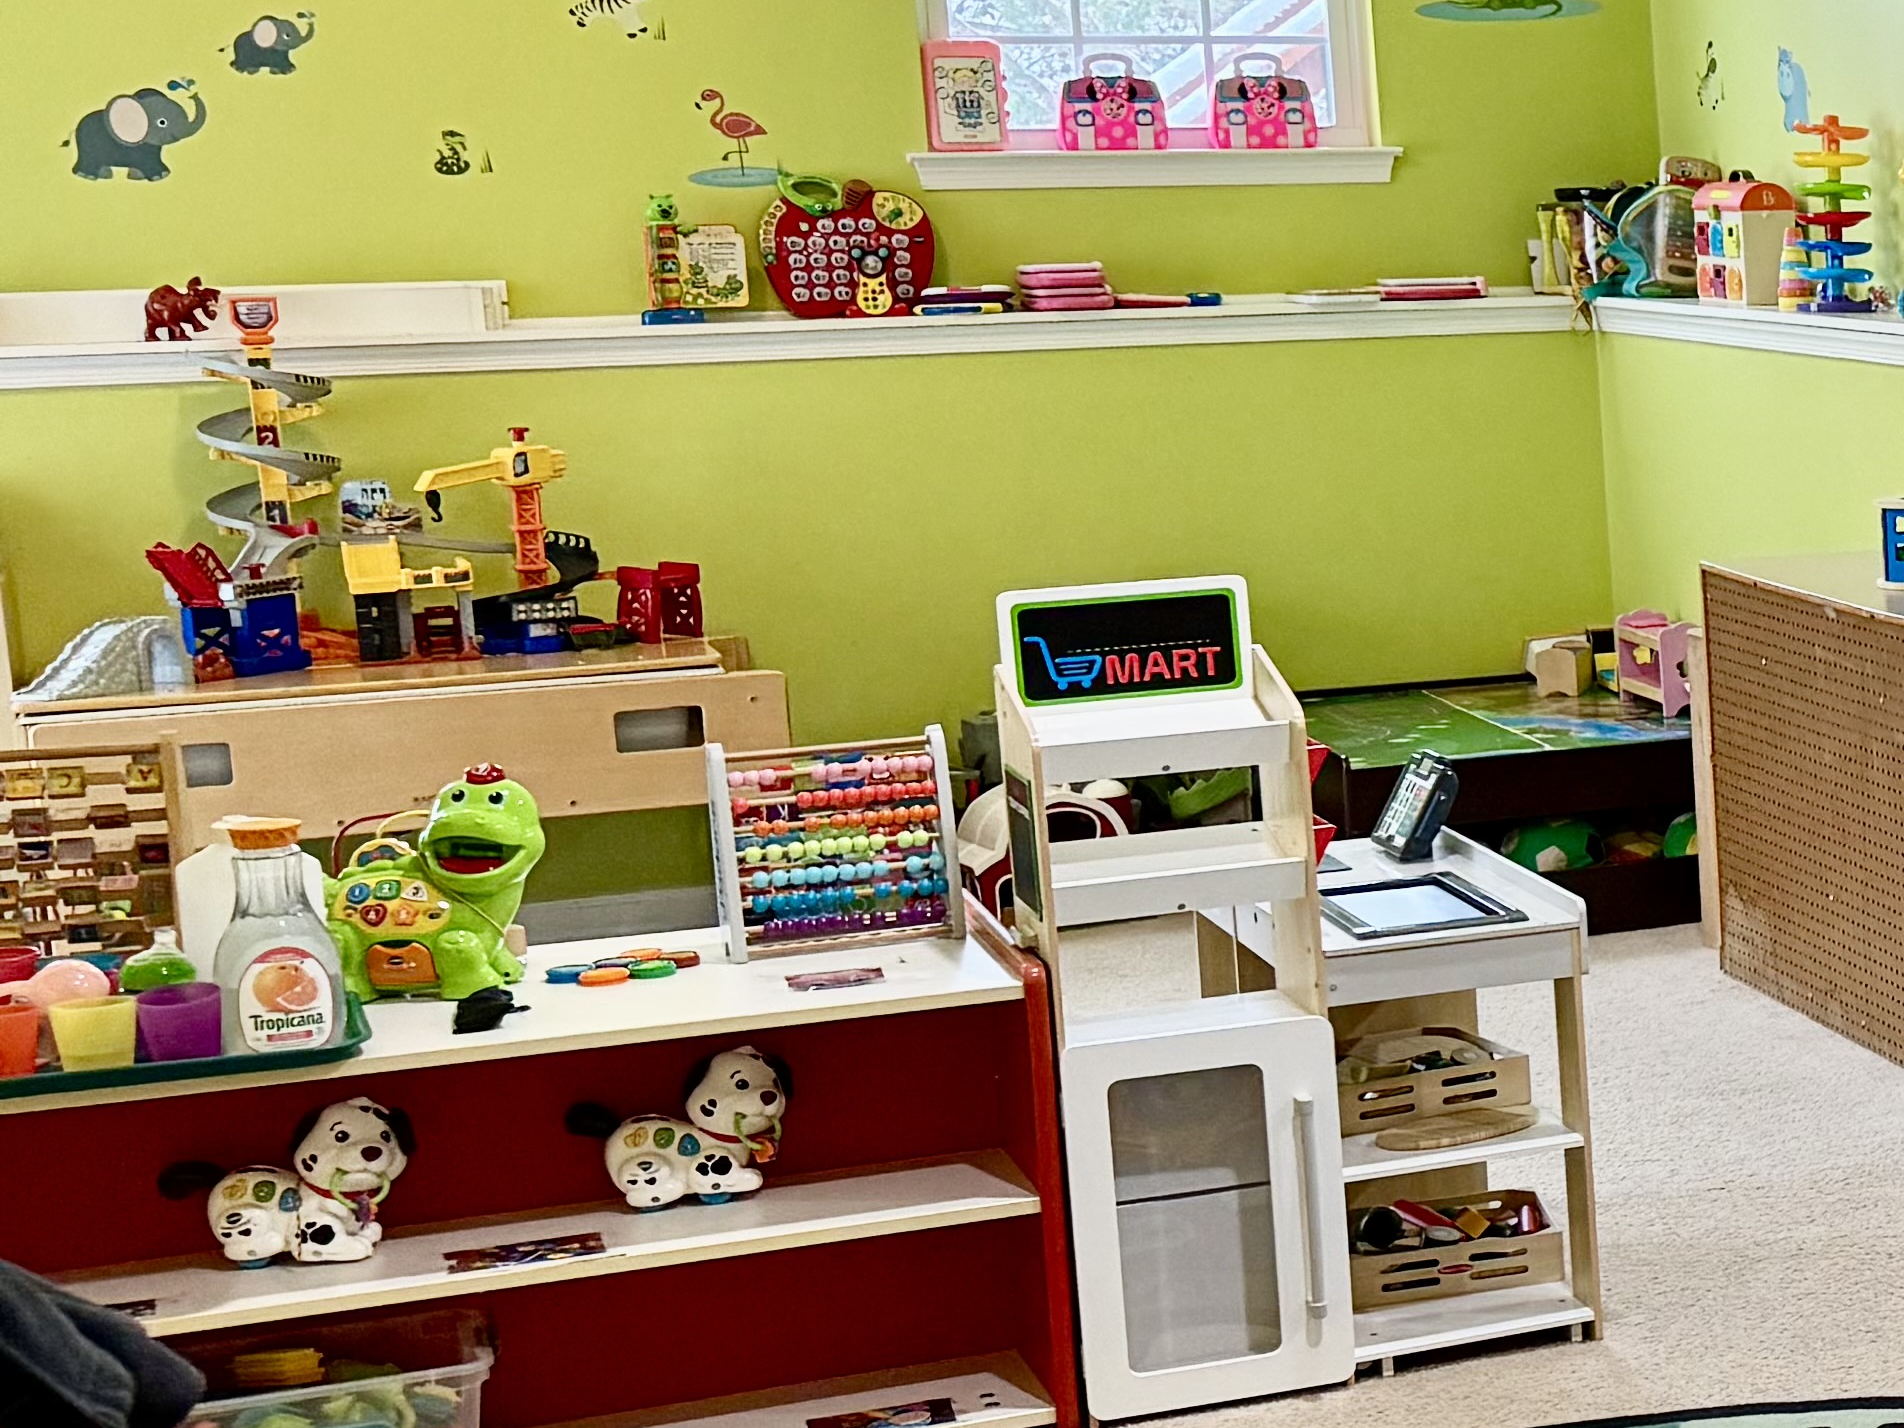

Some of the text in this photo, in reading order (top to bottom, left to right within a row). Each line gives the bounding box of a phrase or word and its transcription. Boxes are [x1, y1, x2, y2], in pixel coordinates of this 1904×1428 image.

[260, 432, 274, 448] 2
[269, 508, 281, 524] 1
[1106, 645, 1222, 684] MART
[248, 1012, 325, 1033] Tropicana
